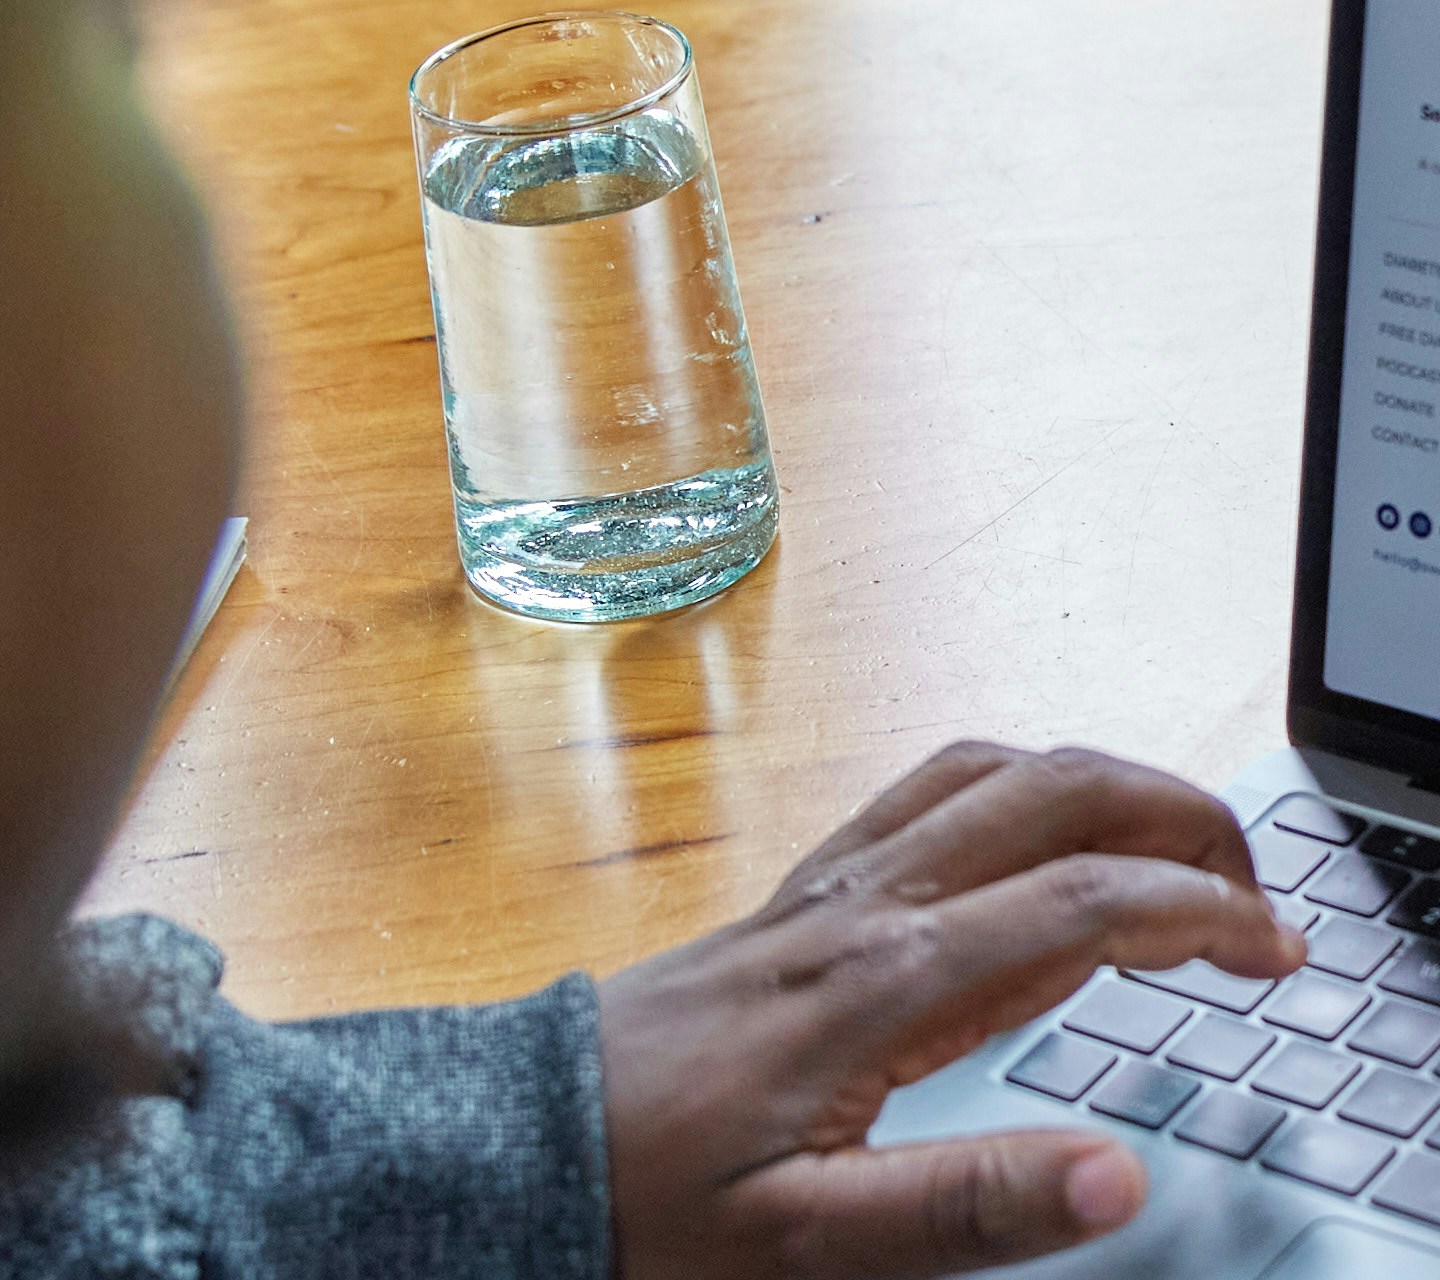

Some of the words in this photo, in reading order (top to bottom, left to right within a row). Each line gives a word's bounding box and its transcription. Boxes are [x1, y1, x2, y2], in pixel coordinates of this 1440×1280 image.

[1380, 287, 1433, 310] ABOUT
[1378, 321, 1416, 344] FREE
[1373, 391, 1436, 419] DONATE
[1370, 425, 1440, 454] CONTACT
